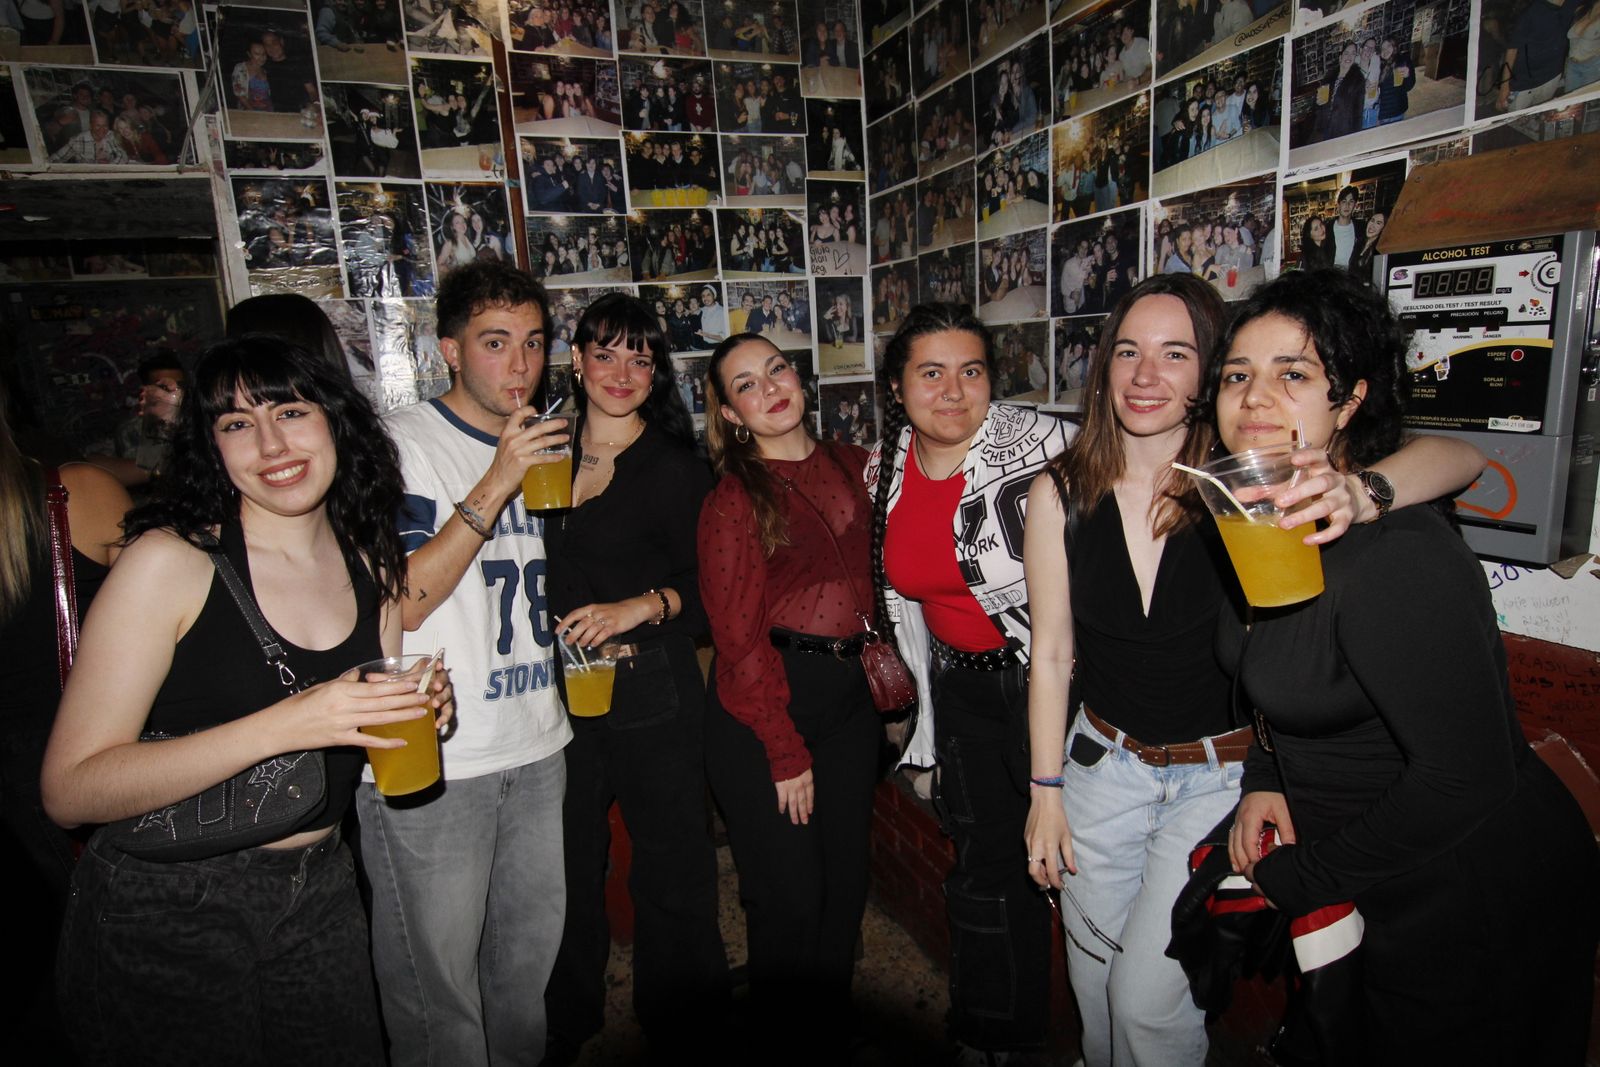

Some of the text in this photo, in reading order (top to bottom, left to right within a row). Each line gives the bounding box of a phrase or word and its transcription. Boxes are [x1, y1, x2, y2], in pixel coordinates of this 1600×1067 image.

[1422, 245, 1491, 262] ALCOHOL TEST
[481, 559, 554, 655] 78
[1512, 652, 1582, 677] RASIL
